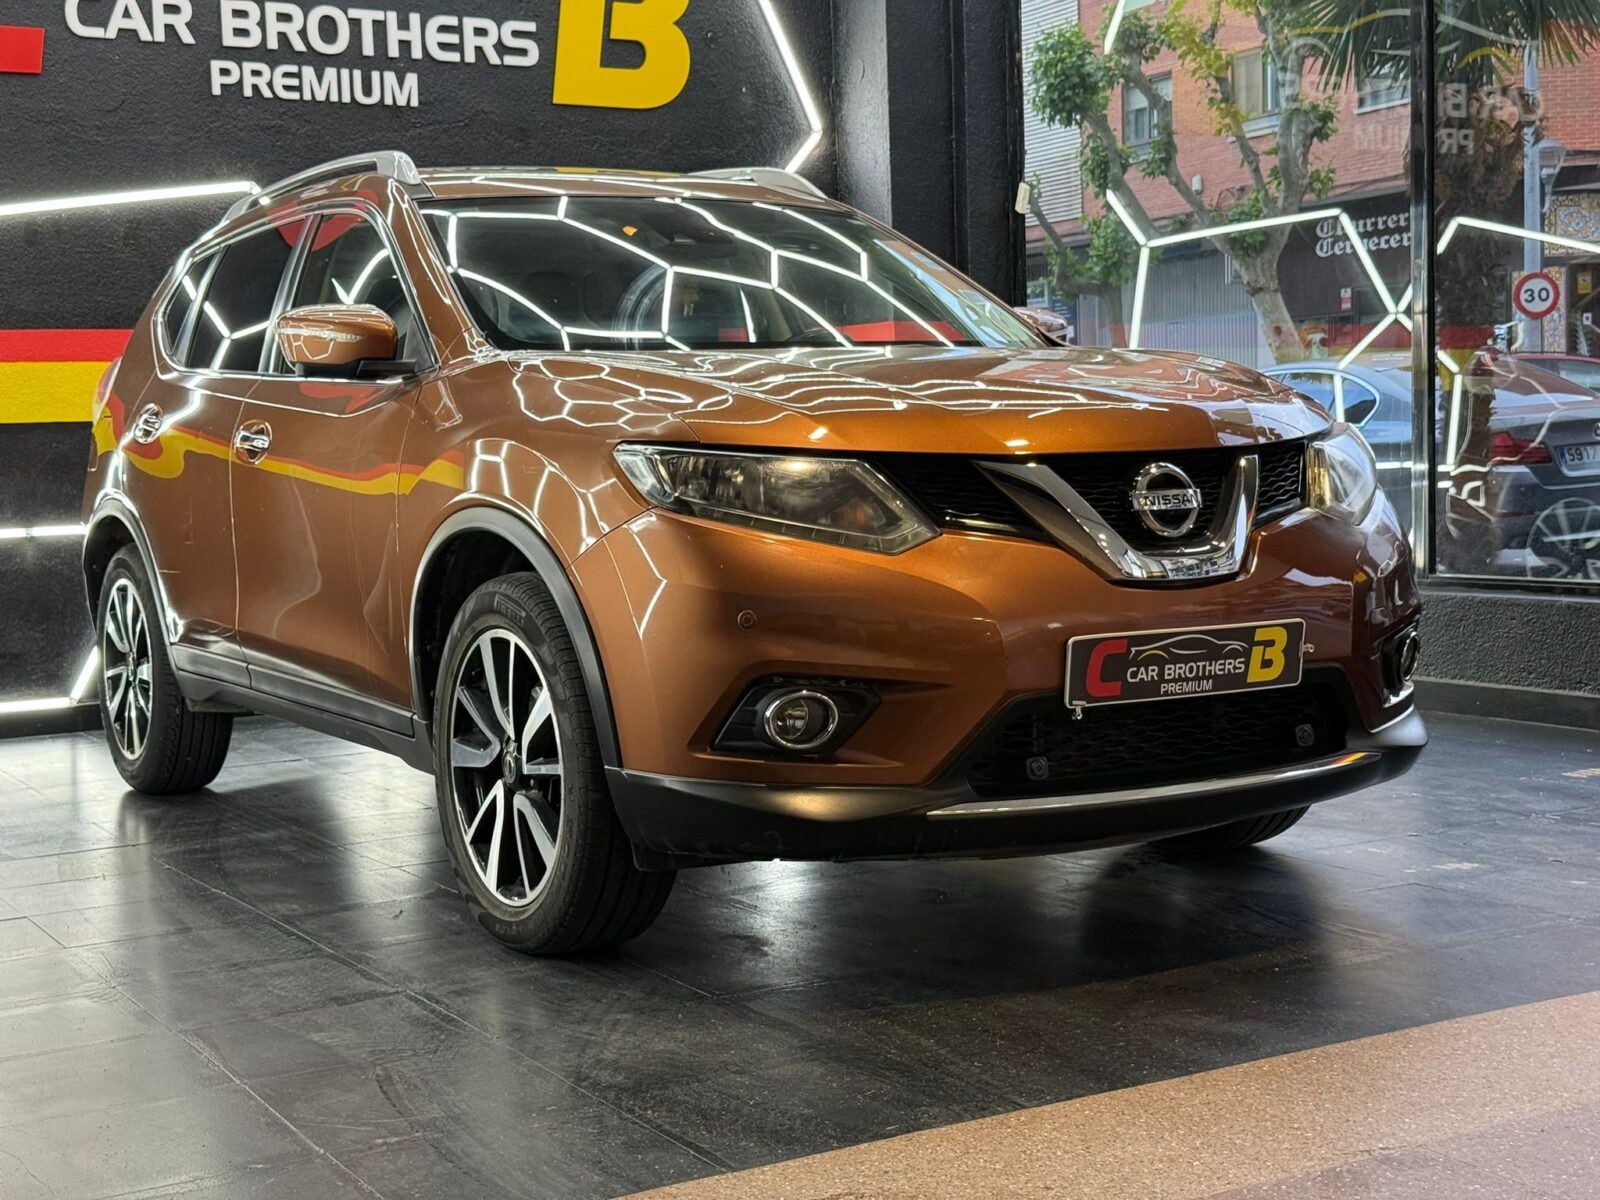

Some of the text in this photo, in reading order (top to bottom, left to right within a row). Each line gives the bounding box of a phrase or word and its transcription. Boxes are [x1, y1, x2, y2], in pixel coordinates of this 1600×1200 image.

[64, 0, 540, 67] CAR BROTHERS
[210, 59, 419, 107] PREMIUM
[1523, 287, 1550, 303] 30
[1143, 493, 1199, 506] NISSAN
[1126, 657, 1246, 683] CAR BROTHERS
[1160, 679, 1213, 695] PREMIUM
